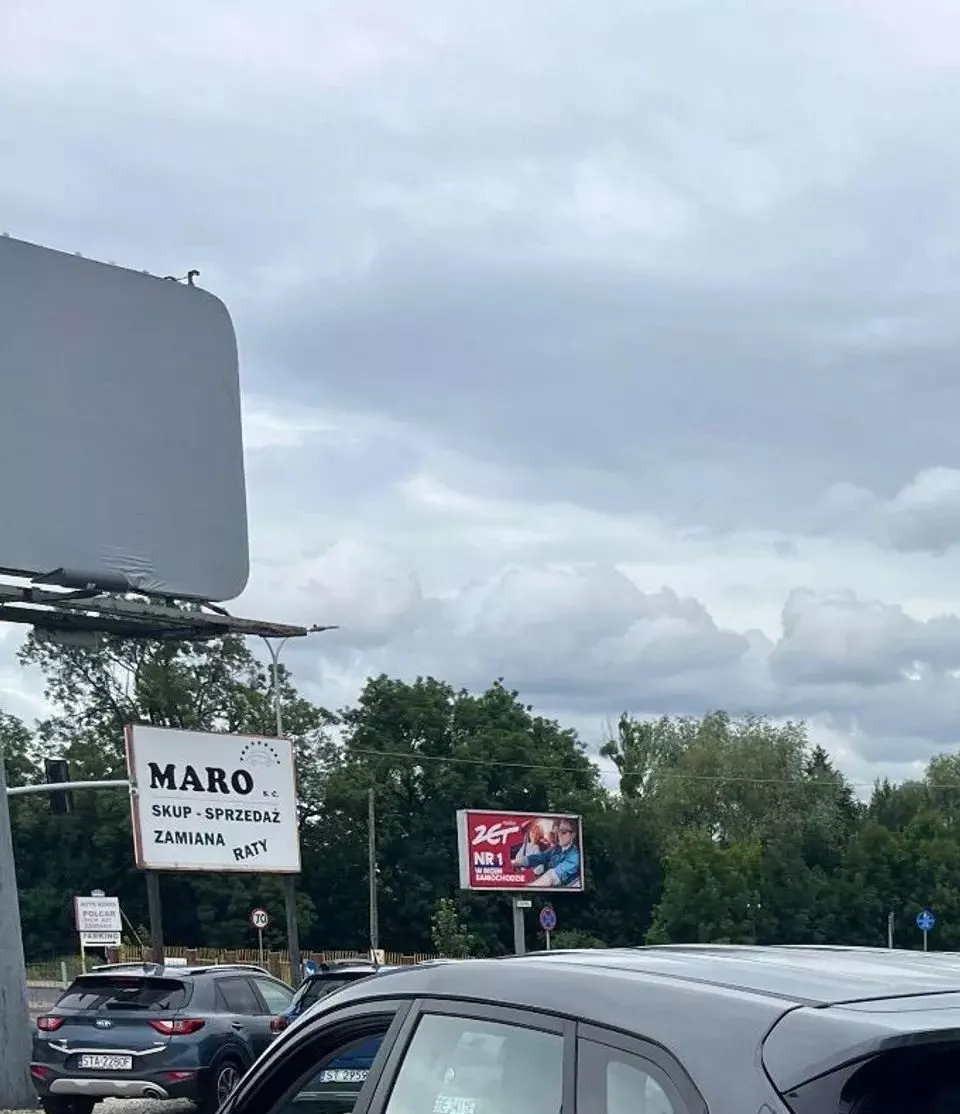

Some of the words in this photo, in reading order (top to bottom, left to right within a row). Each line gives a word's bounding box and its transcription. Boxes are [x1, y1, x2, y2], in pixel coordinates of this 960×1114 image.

[148, 762, 254, 796] MARO
[152, 804, 192, 819] SKUP
[205, 807, 281, 823] SPRZEDAŻ
[154, 830, 226, 846] ZAMIANA
[233, 839, 268, 861] RATY
[474, 851, 494, 866] NR
[497, 852, 503, 866] 1
[255, 913, 267, 924] 70
